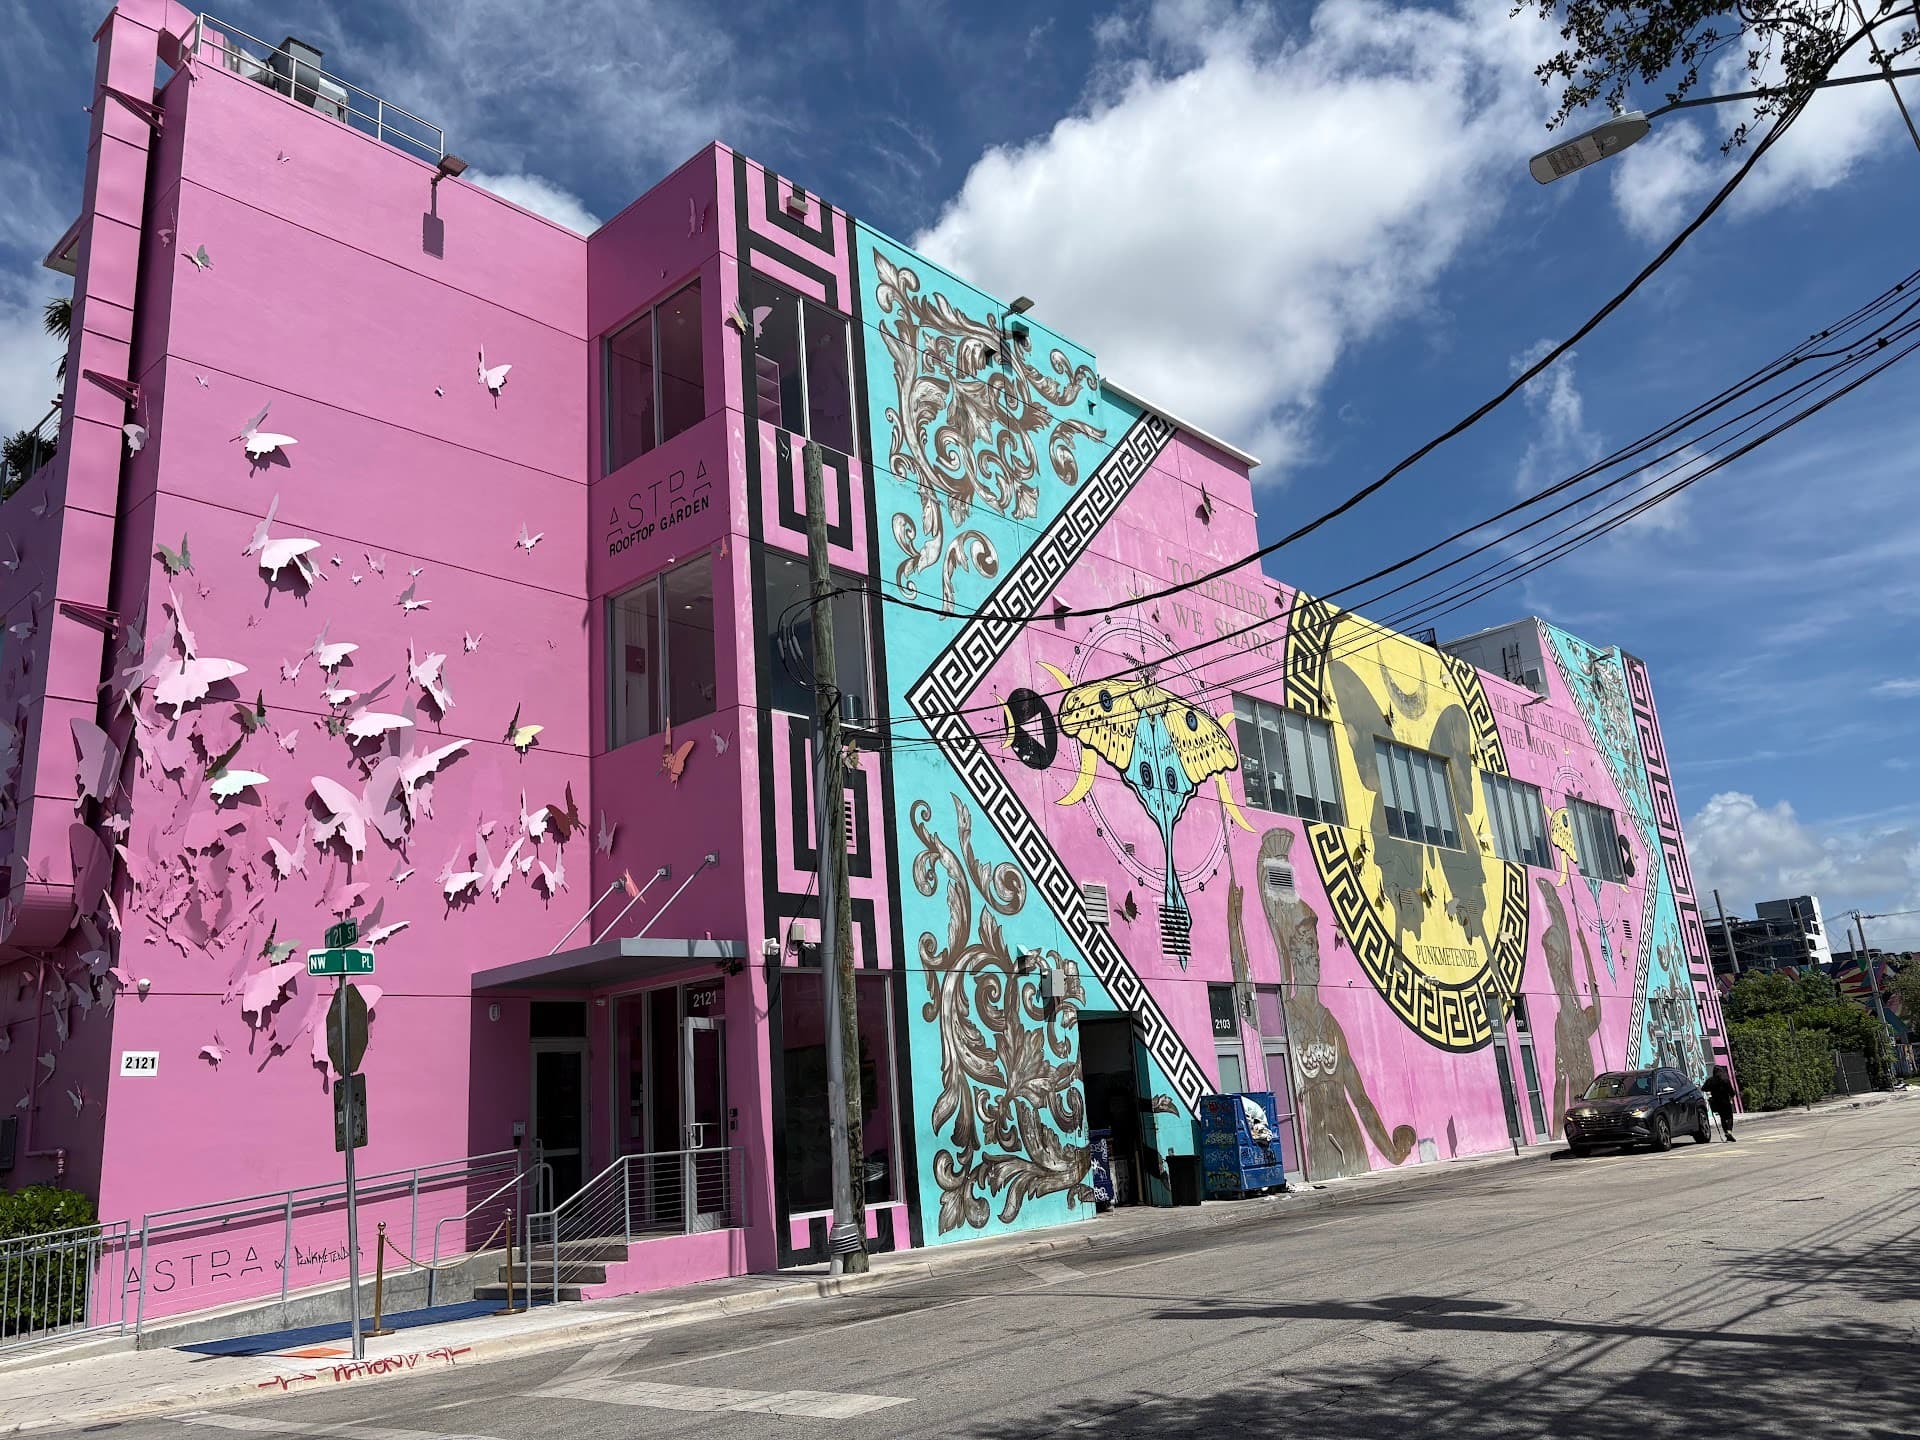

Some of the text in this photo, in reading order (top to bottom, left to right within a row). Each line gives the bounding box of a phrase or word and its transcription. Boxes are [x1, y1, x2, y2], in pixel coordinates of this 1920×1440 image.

[606, 459, 712, 542] ASTRA
[609, 495, 710, 559] ROOFTOP GARDEN
[1166, 556, 1270, 620] TOGETHER
[1171, 600, 1205, 637] WE
[1492, 692, 1510, 714] WE
[1539, 711, 1555, 732] WE
[1501, 725, 1558, 762] THE MOON
[347, 925, 356, 940] ST
[310, 951, 372, 971] NW 1 PL
[1415, 944, 1480, 968] PUNKMETENDER
[692, 990, 717, 1008] 2121
[1214, 1018, 1231, 1029] 2103
[125, 1056, 156, 1070] 2121
[121, 1246, 263, 1299] ASTRA
